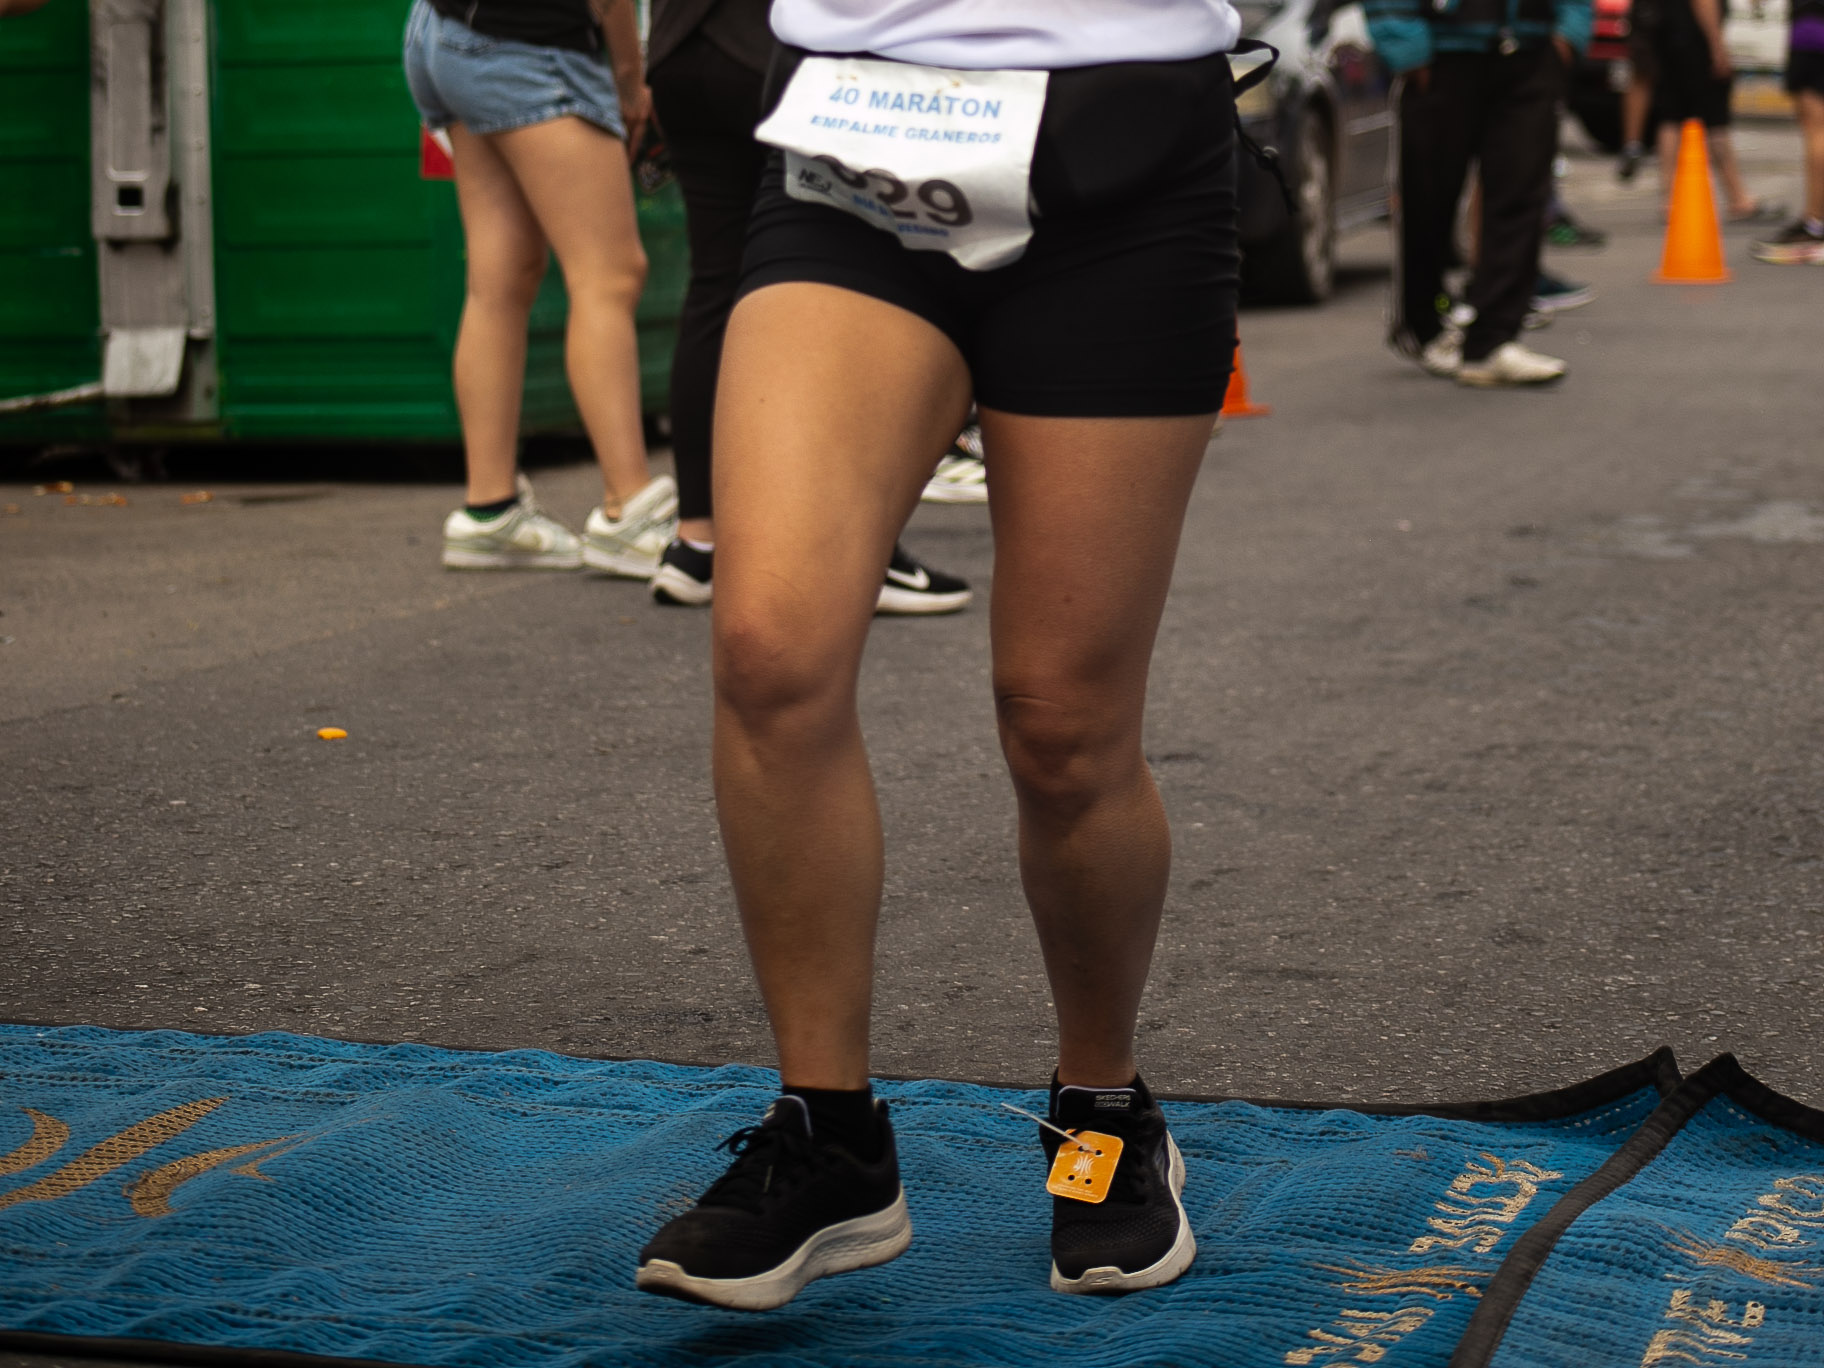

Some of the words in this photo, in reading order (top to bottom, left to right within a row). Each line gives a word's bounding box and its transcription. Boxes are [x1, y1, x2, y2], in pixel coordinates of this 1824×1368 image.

[829, 86, 860, 105] 40
[809, 114, 898, 138] EMPALME
[904, 126, 1003, 145] GRANEROS
